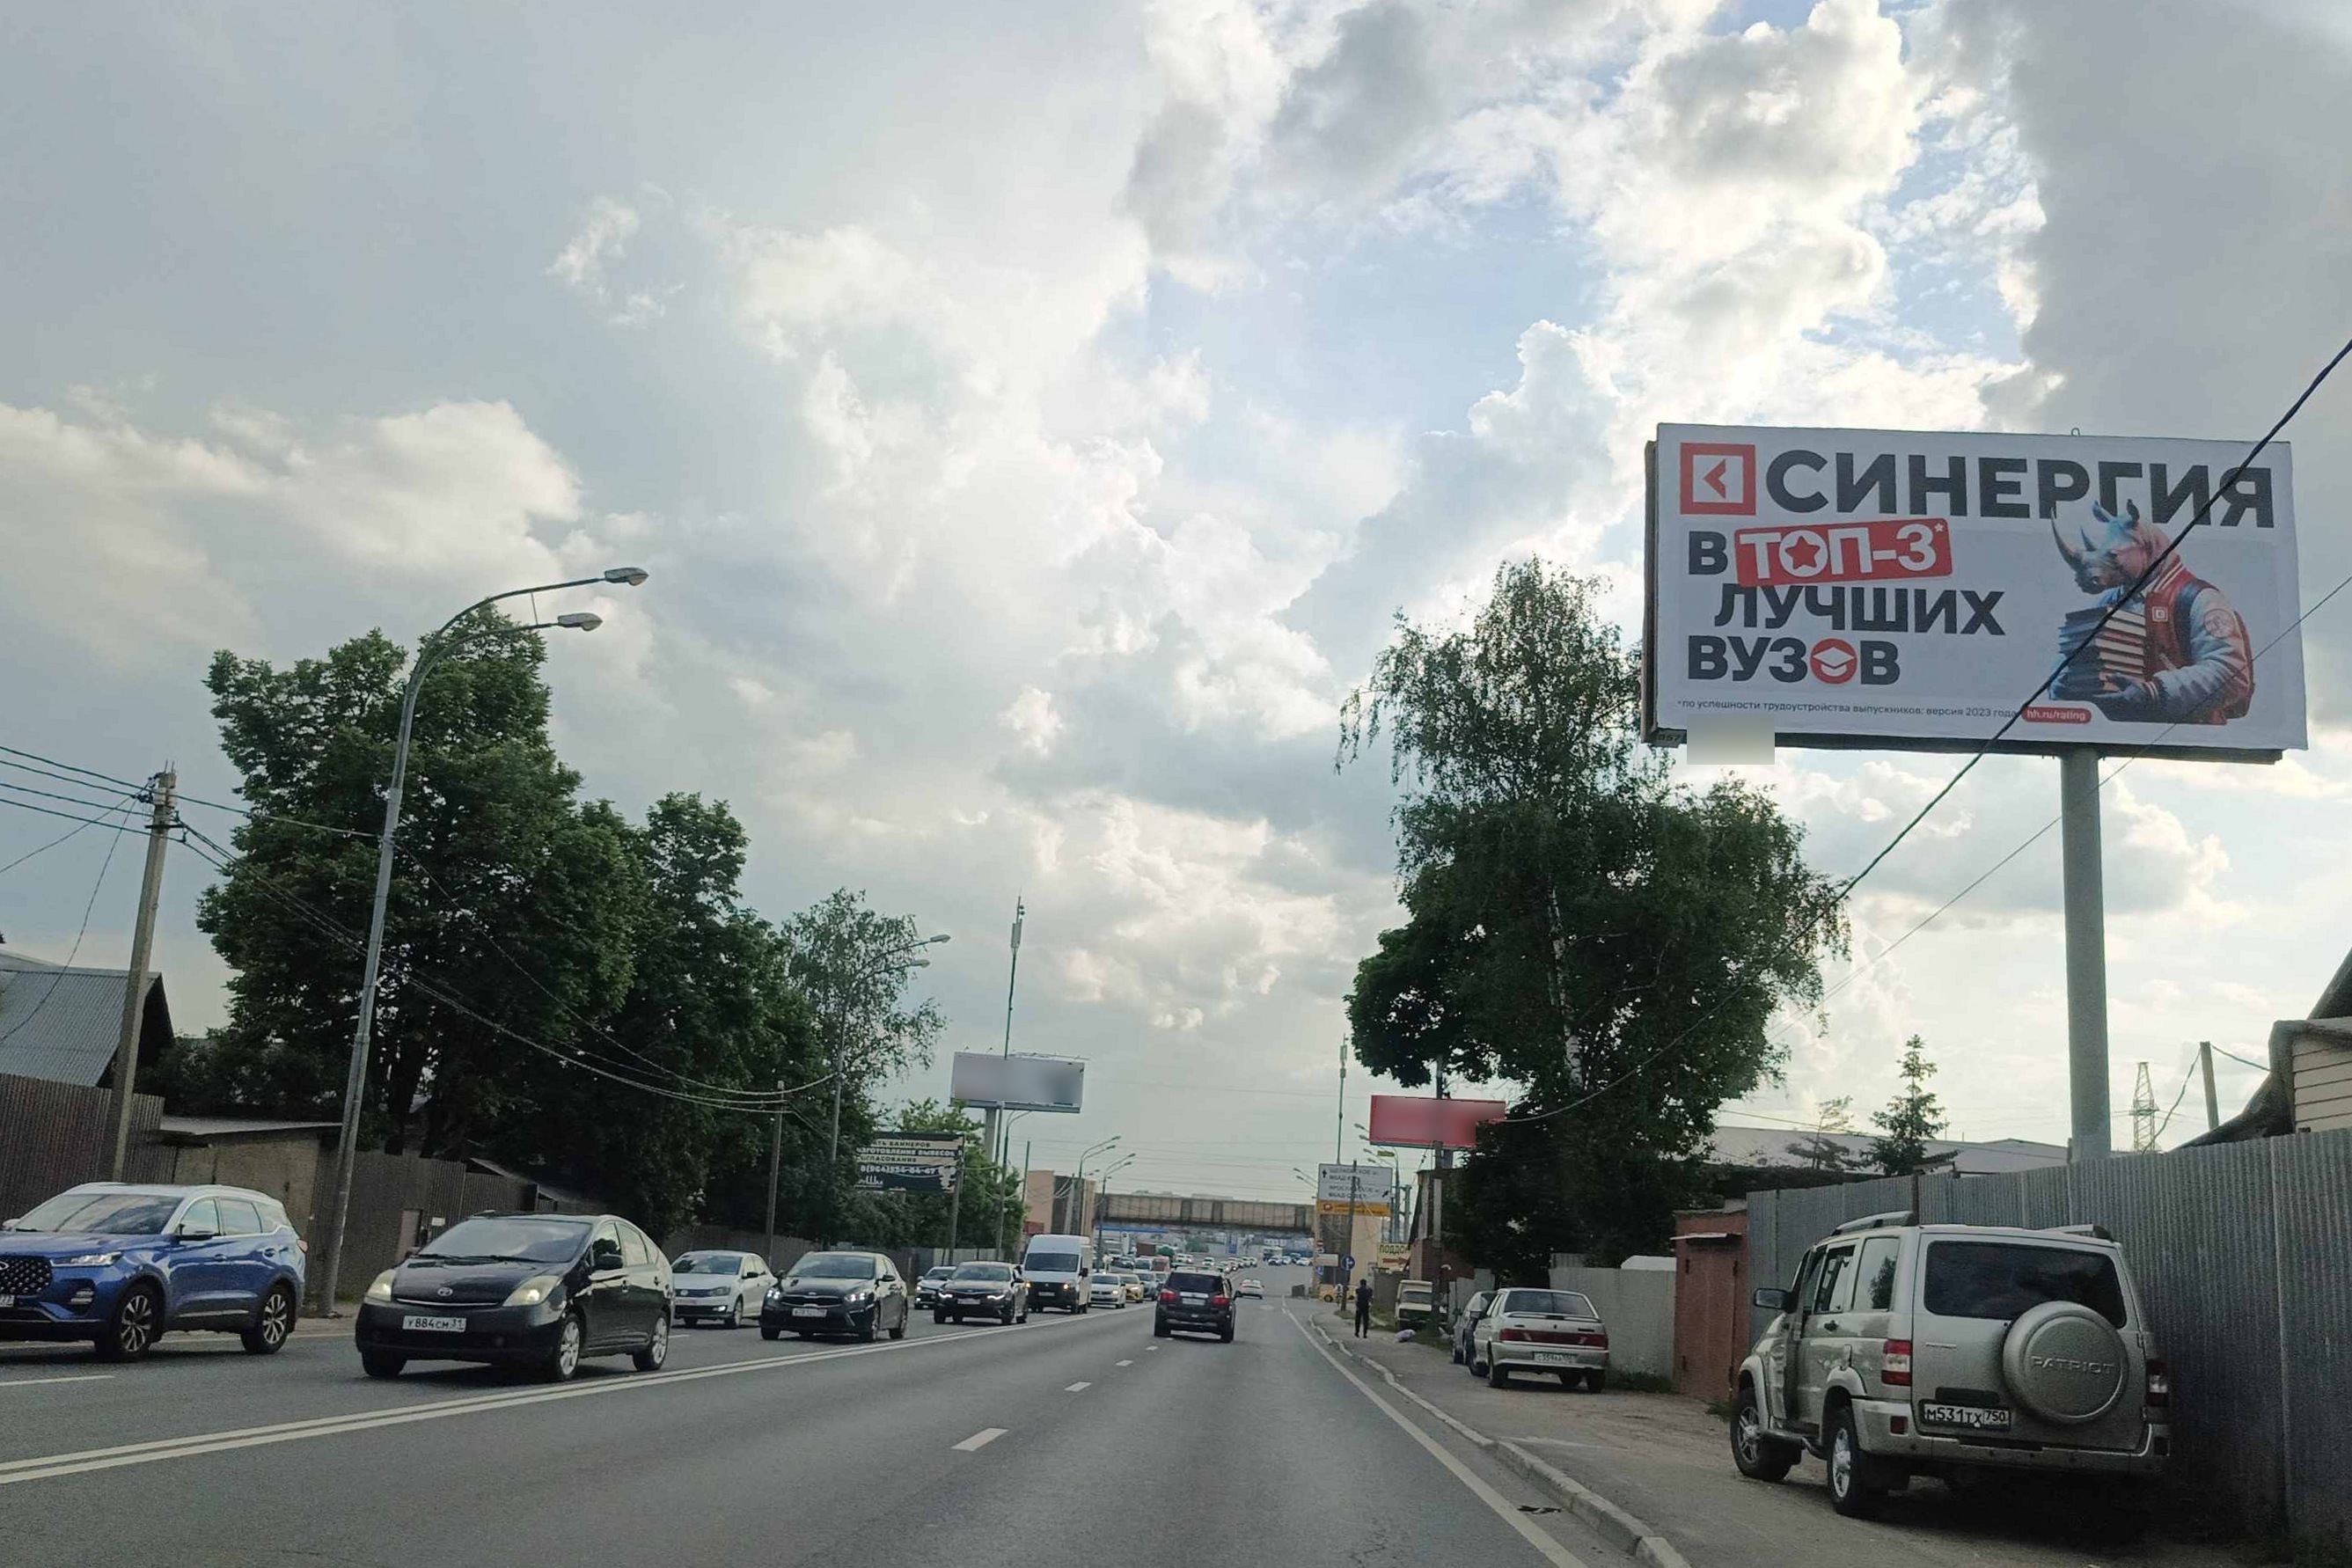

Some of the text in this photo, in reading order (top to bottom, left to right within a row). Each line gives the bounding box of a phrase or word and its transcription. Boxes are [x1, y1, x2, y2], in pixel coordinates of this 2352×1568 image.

[1765, 449, 2275, 528] СИНЕРГИЯ
[1689, 531, 1728, 575] В
[1714, 583, 2006, 635] ЛУЧШИХ
[1688, 634, 1901, 685] ВУЗОВ
[1697, 700, 1761, 711] успешности
[1763, 702, 1850, 714] трудоустройства
[1926, 707, 1963, 718] версия
[1965, 707, 1991, 717] 2023
[2026, 707, 2086, 722] hh.ru/rating
[2030, 1355, 2118, 1374] PATRIOT
